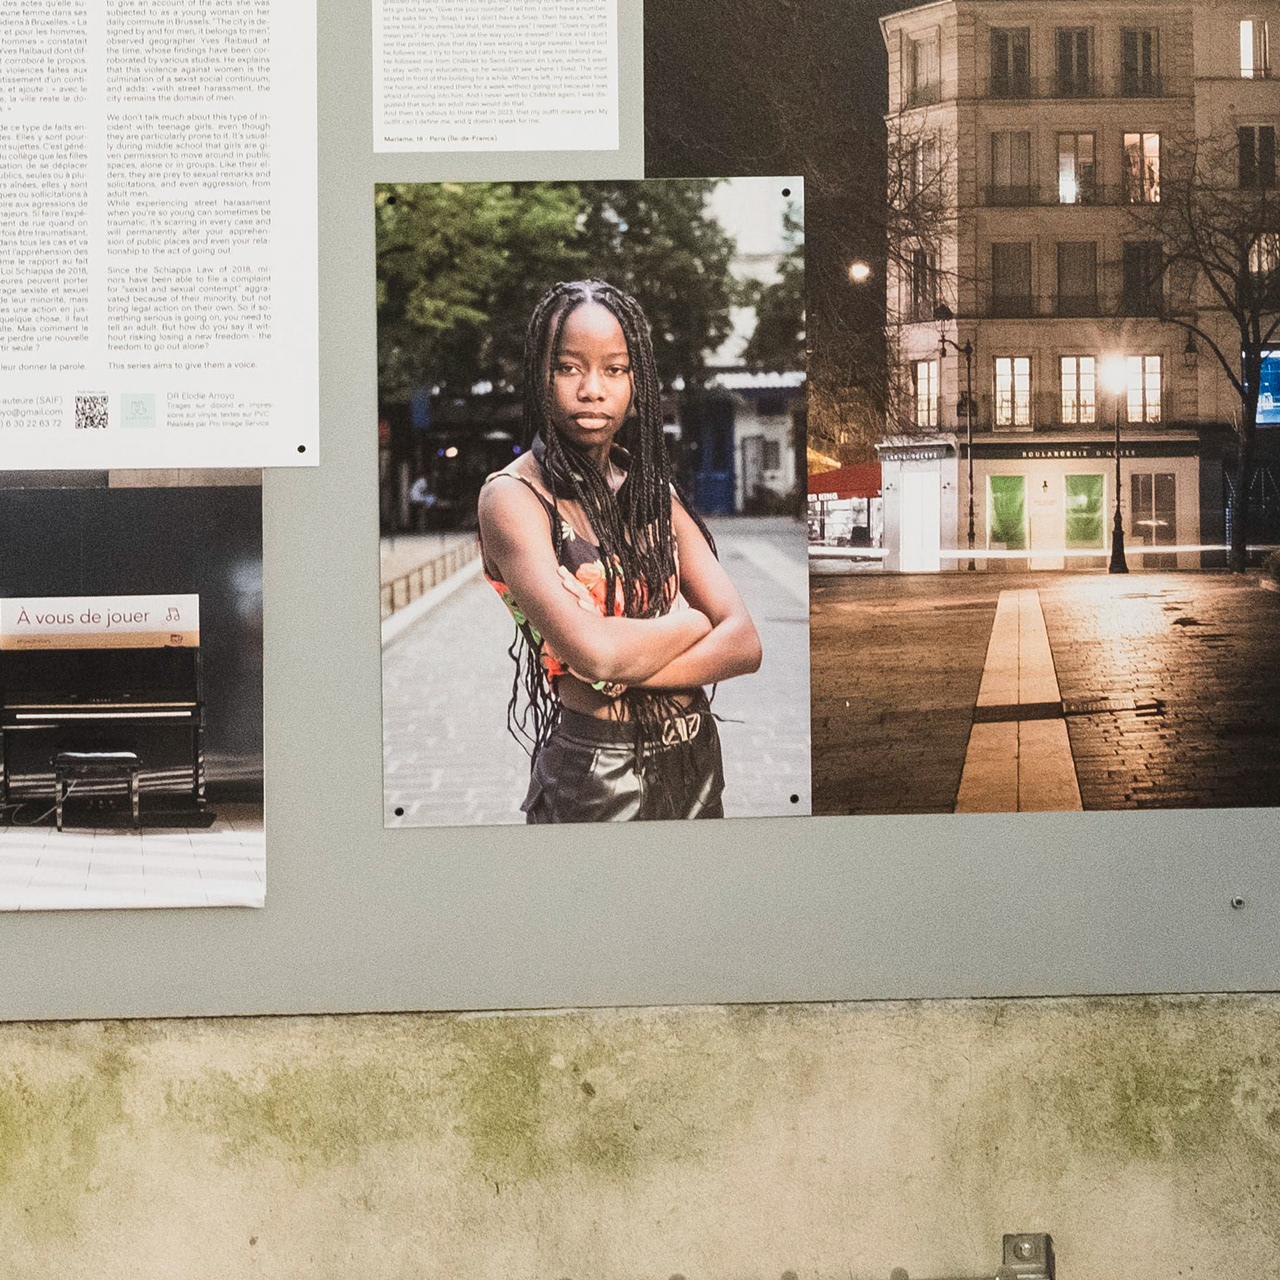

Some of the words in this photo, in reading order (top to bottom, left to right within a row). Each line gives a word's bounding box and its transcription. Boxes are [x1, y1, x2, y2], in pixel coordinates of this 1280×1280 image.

[16, 606, 30, 624] À
[35, 613, 75, 624] vous
[79, 608, 101, 624] de
[106, 609, 149, 627] jouer
